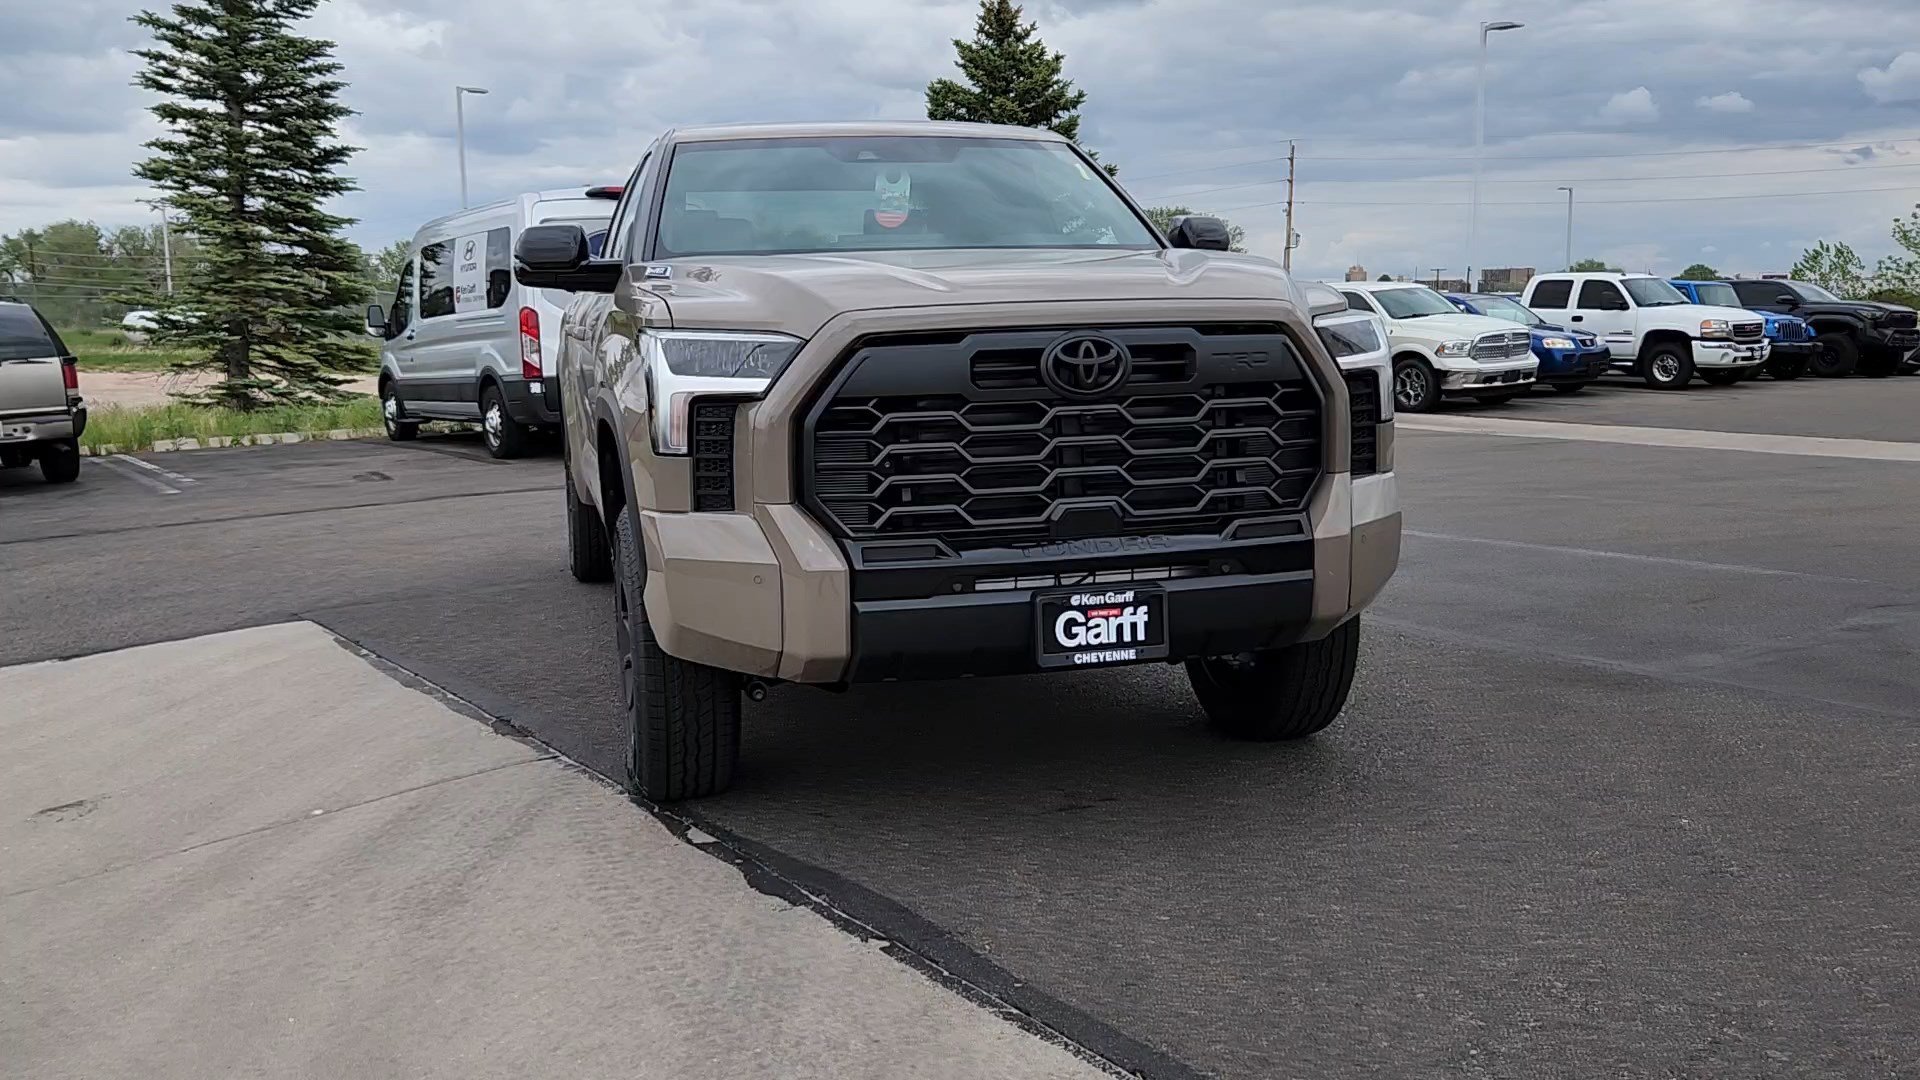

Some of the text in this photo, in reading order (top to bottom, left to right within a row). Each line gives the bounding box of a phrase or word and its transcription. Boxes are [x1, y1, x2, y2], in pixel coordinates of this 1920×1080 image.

[1211, 351, 1269, 369] TRD
[1011, 535, 1171, 557] TUNDRA
[1081, 590, 1135, 605] Ken Garff
[1055, 605, 1149, 648] Garff
[1073, 648, 1137, 664] CHEYENNE
